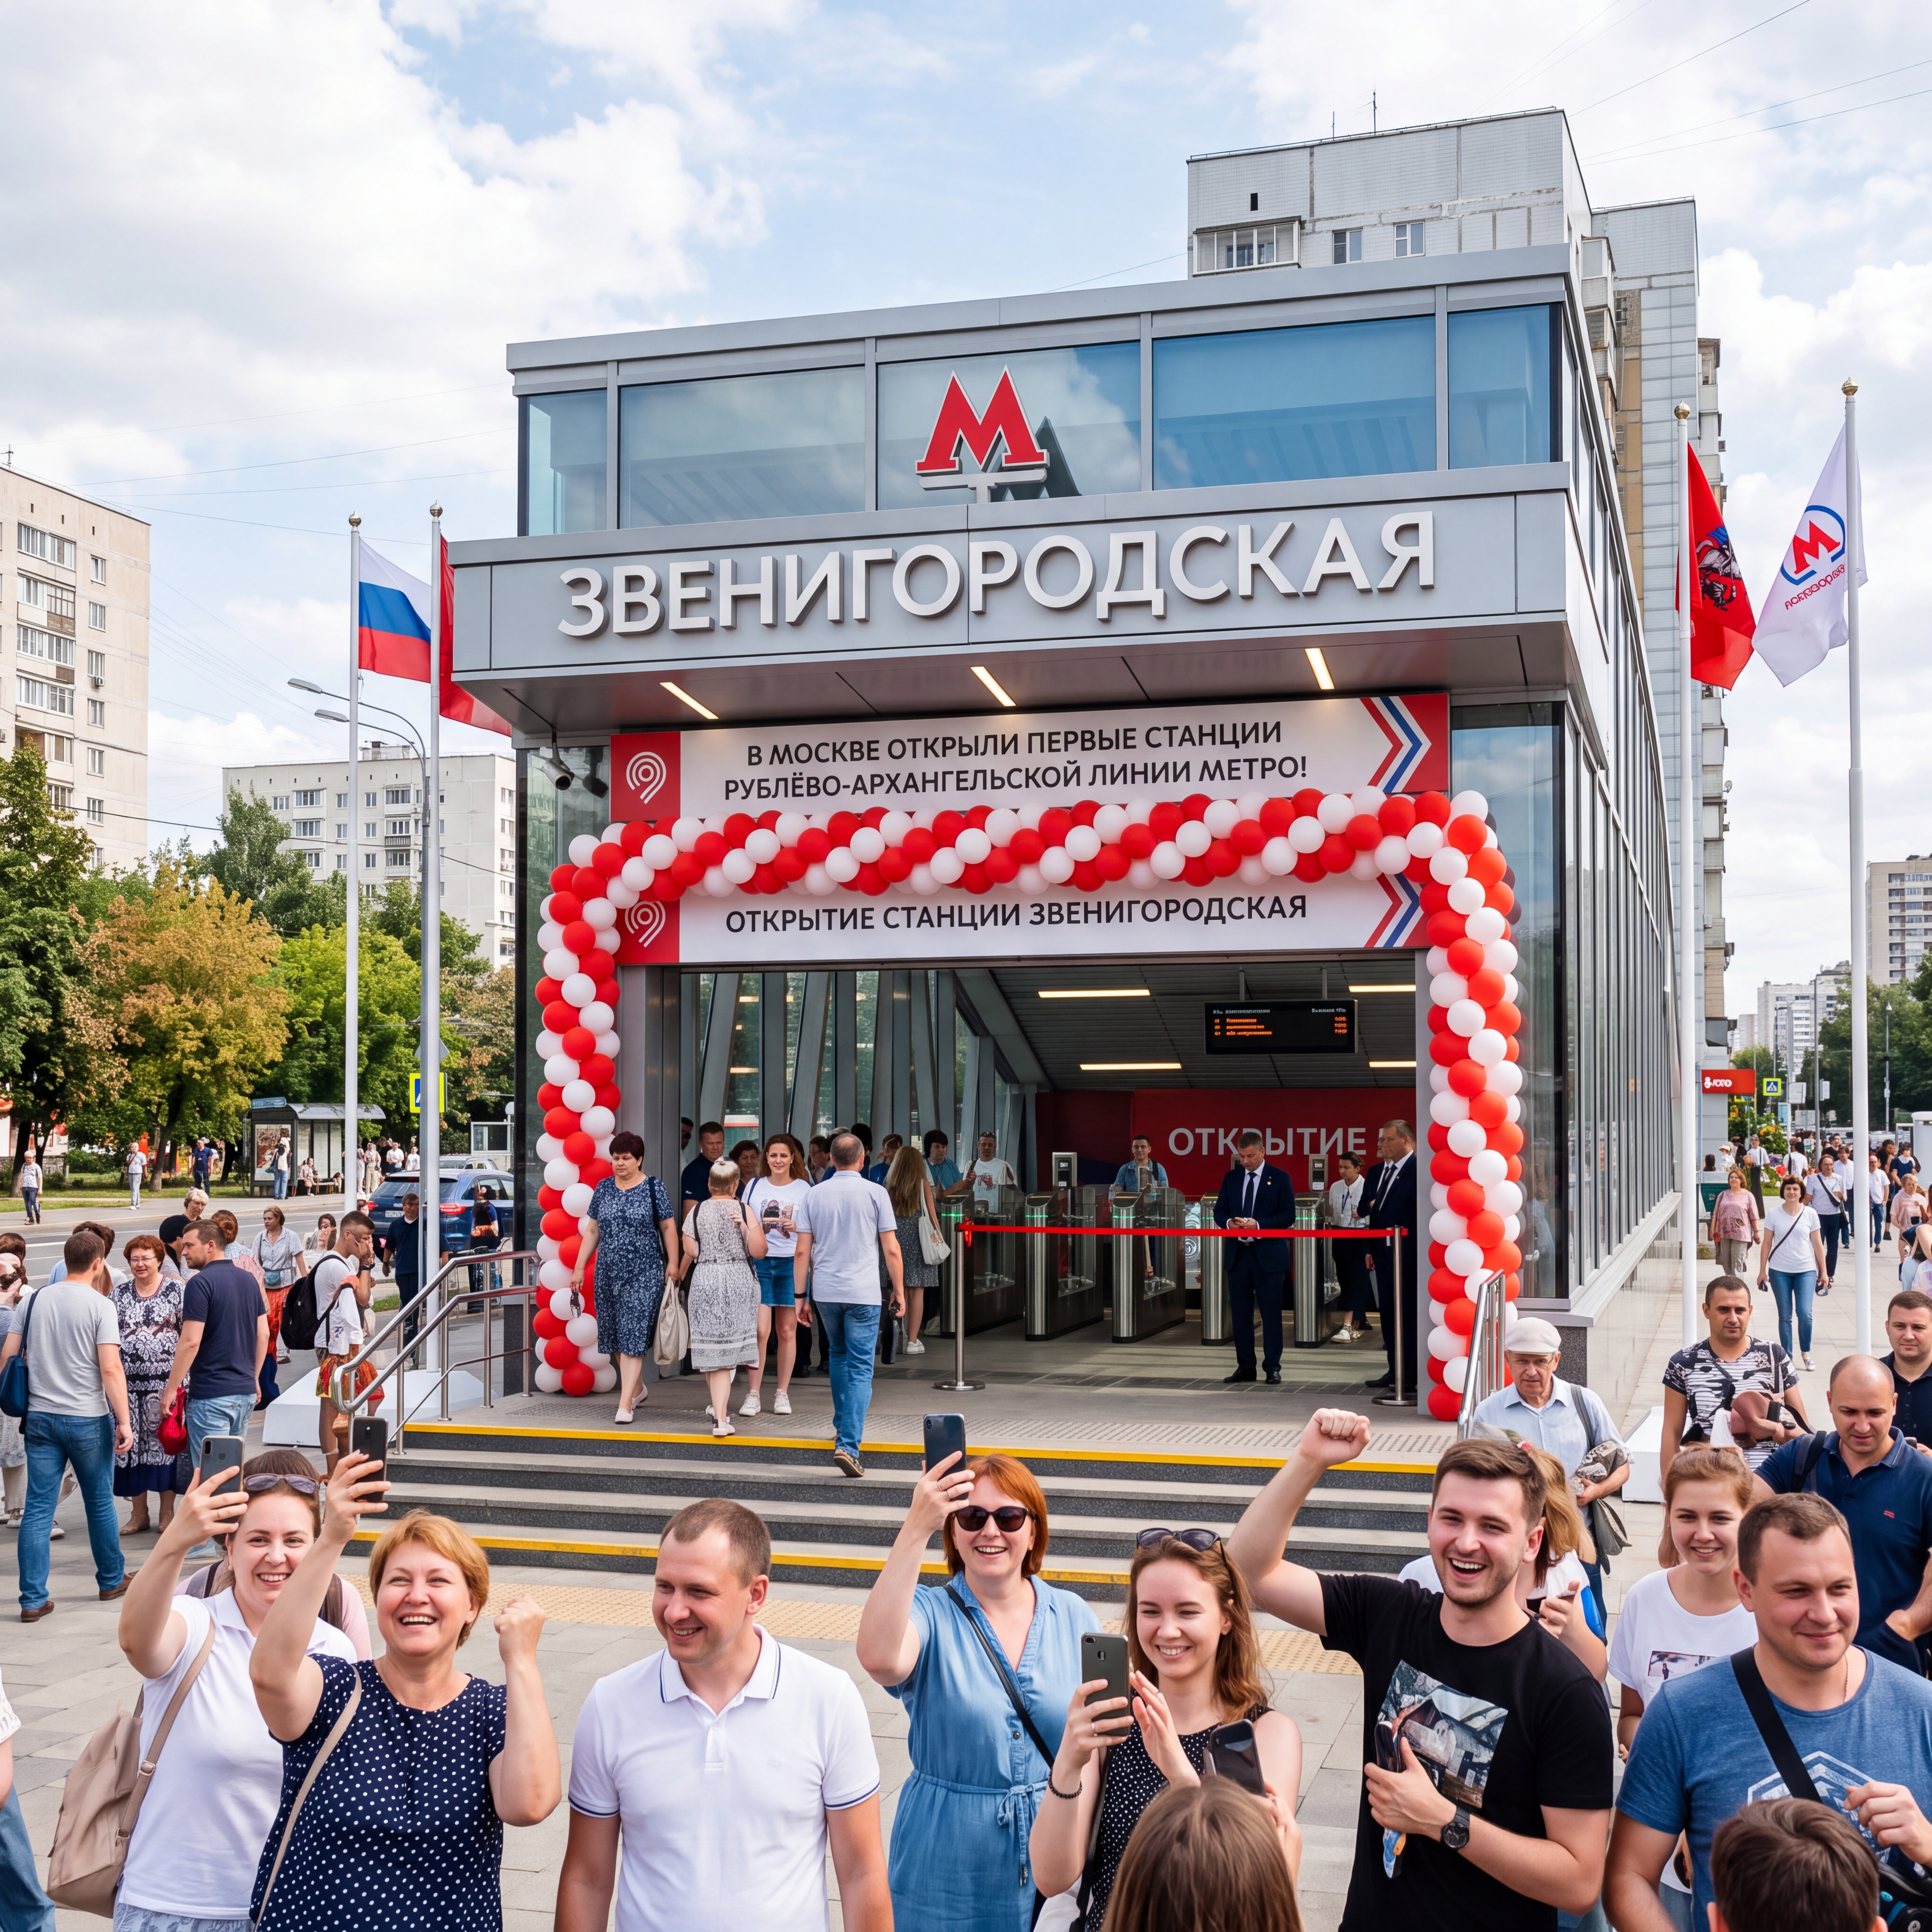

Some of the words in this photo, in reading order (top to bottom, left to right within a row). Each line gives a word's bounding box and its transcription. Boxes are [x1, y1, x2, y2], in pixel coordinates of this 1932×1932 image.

[558, 510, 1435, 639] ЗВЕНИГОРОДСКАЯ
[748, 745, 762, 766] В
[769, 740, 880, 765] МОСКВЕ
[887, 733, 1018, 760] ОТКРЫЛИ
[1028, 727, 1137, 754] ПЕРВЫЕ
[1145, 721, 1281, 749] СТАНЦИИ
[725, 760, 1081, 800] РУБЛЁВО-АРХАНГЕЛЬСКОЙ
[1088, 761, 1190, 786] ЛИНИИ
[1199, 756, 1307, 782] МЕТРО!
[726, 907, 874, 933] ОТКРЫТИЕ
[883, 903, 1020, 931] СТАНЦИИ
[1029, 895, 1307, 925] ЗВЕНИГОРОДСКАЯ
